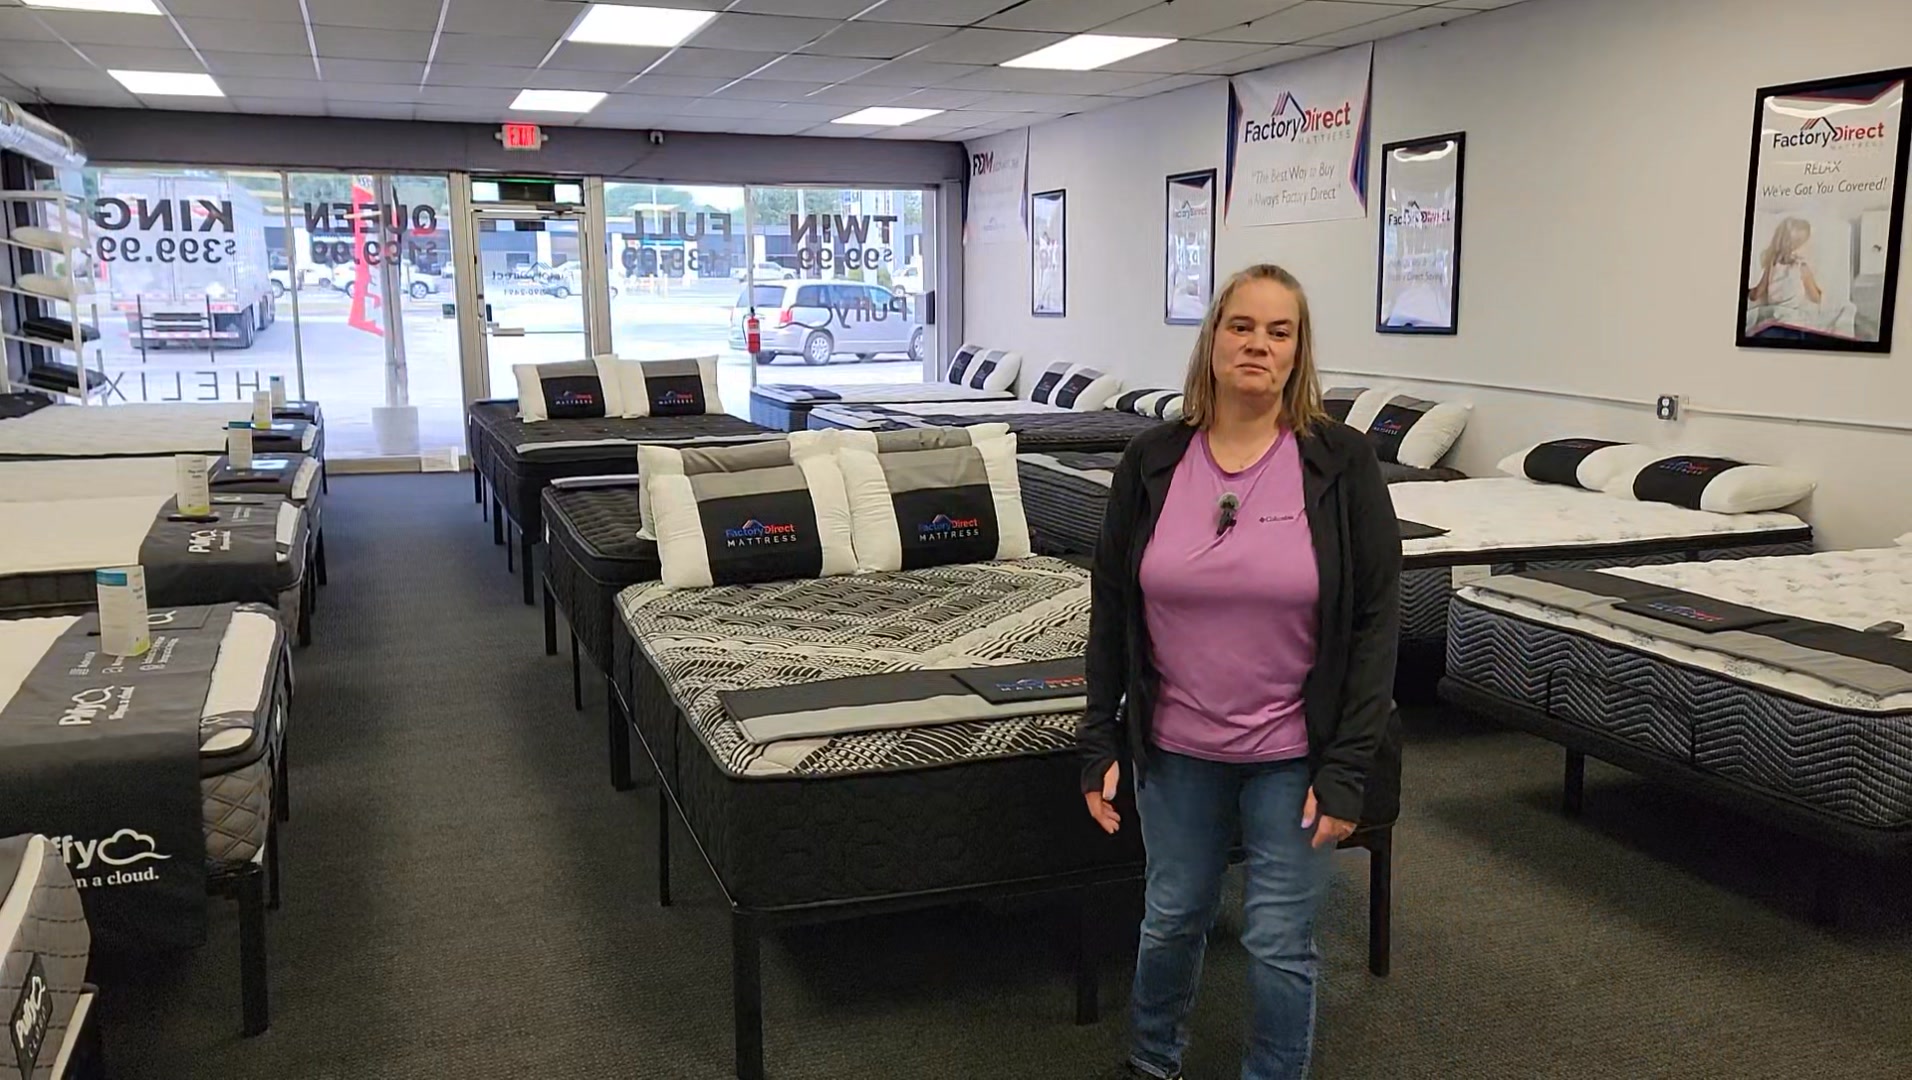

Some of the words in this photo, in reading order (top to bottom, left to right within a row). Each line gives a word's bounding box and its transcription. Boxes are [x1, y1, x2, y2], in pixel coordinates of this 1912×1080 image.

[508, 125, 536, 146] EXIT
[1289, 166, 1307, 180] Way
[1319, 162, 1335, 178] Buy
[1804, 160, 1842, 175] RELAX
[1762, 184, 1791, 198] We've
[1794, 183, 1813, 196] Got
[1817, 181, 1834, 194] You
[1838, 177, 1888, 193] Covered!
[727, 534, 797, 548] MATTRESS
[920, 528, 979, 541] MATTRESS
[51, 835, 98, 869] ffy
[92, 876, 102, 886] a
[107, 867, 160, 886] cloud.
